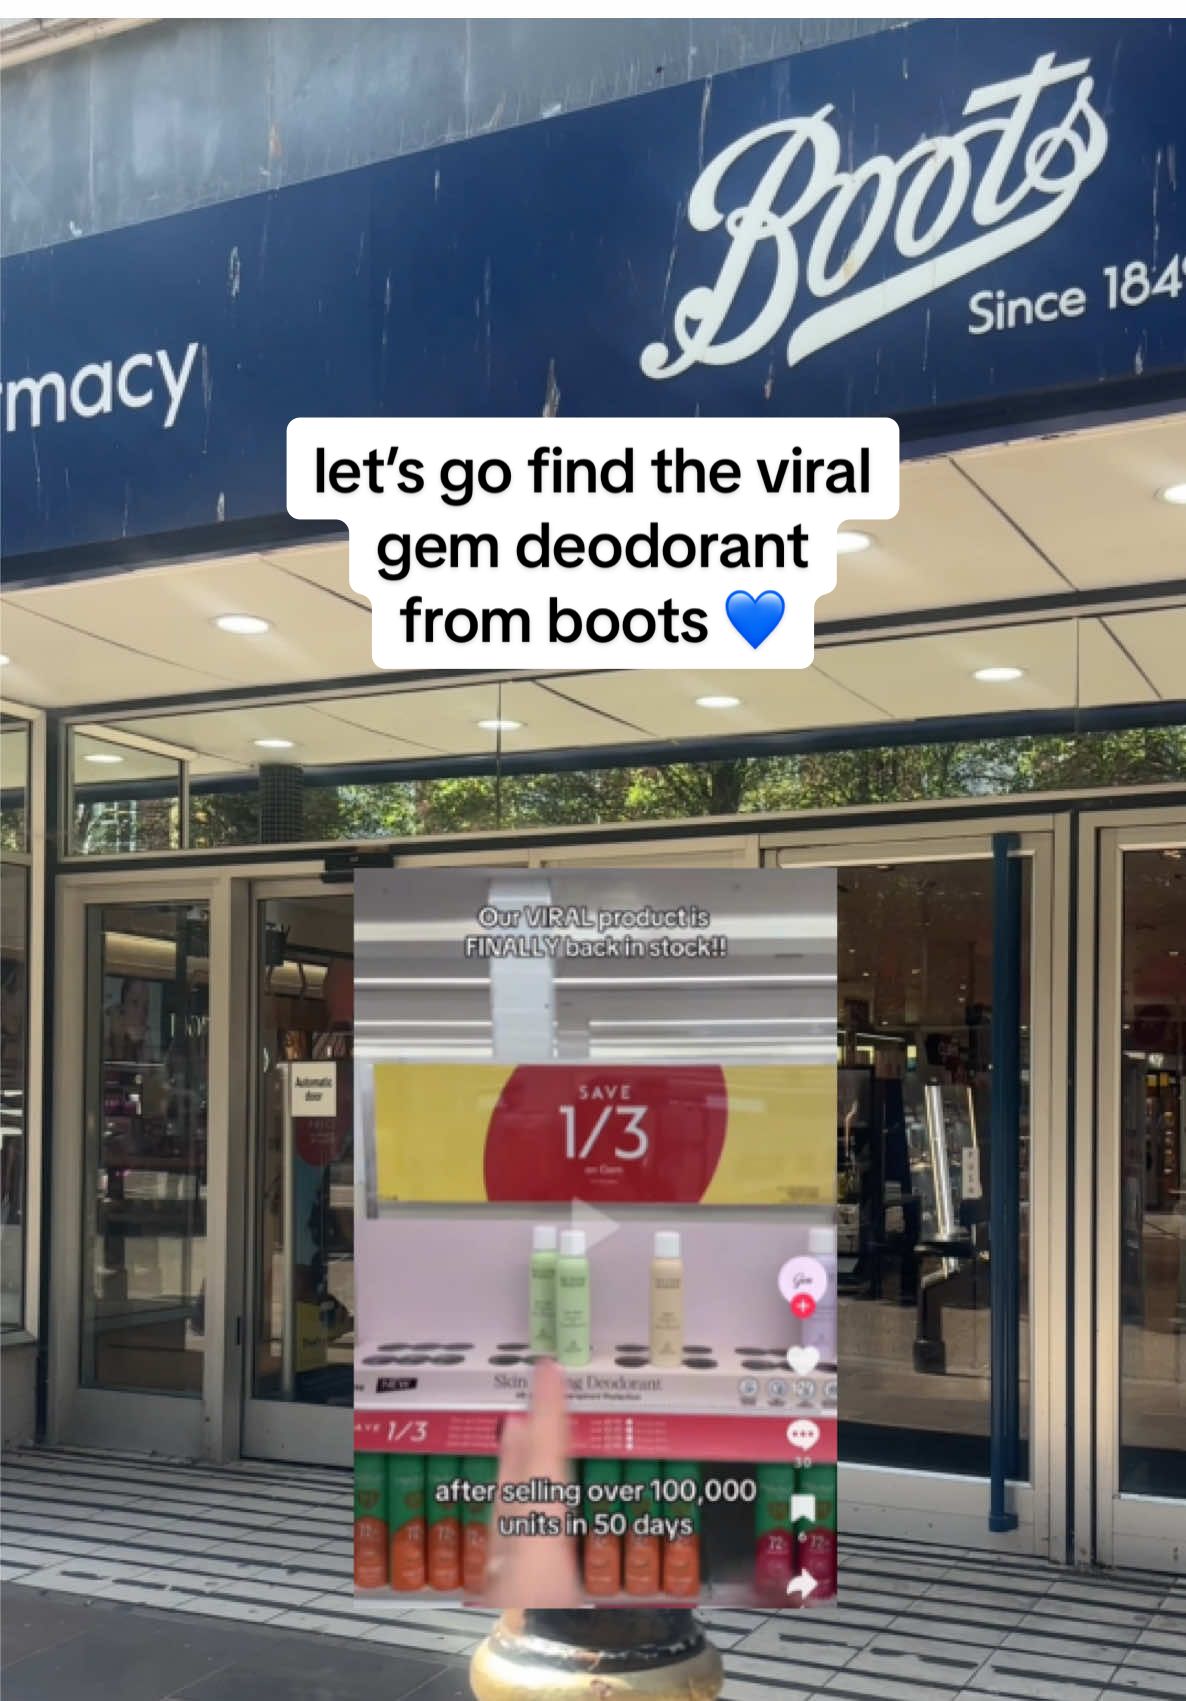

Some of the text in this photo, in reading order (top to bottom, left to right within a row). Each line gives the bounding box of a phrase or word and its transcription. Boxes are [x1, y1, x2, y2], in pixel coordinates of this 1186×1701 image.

[640, 52, 1108, 379] Boots
[968, 288, 1087, 334] Since
[0, 342, 199, 432] macy
[578, 1084, 632, 1100] SAVE
[559, 1104, 649, 1160] 1/3
[494, 1374, 529, 1390] Skin
[587, 1375, 664, 1391] Deodorant
[387, 1420, 429, 1442] 1/3
